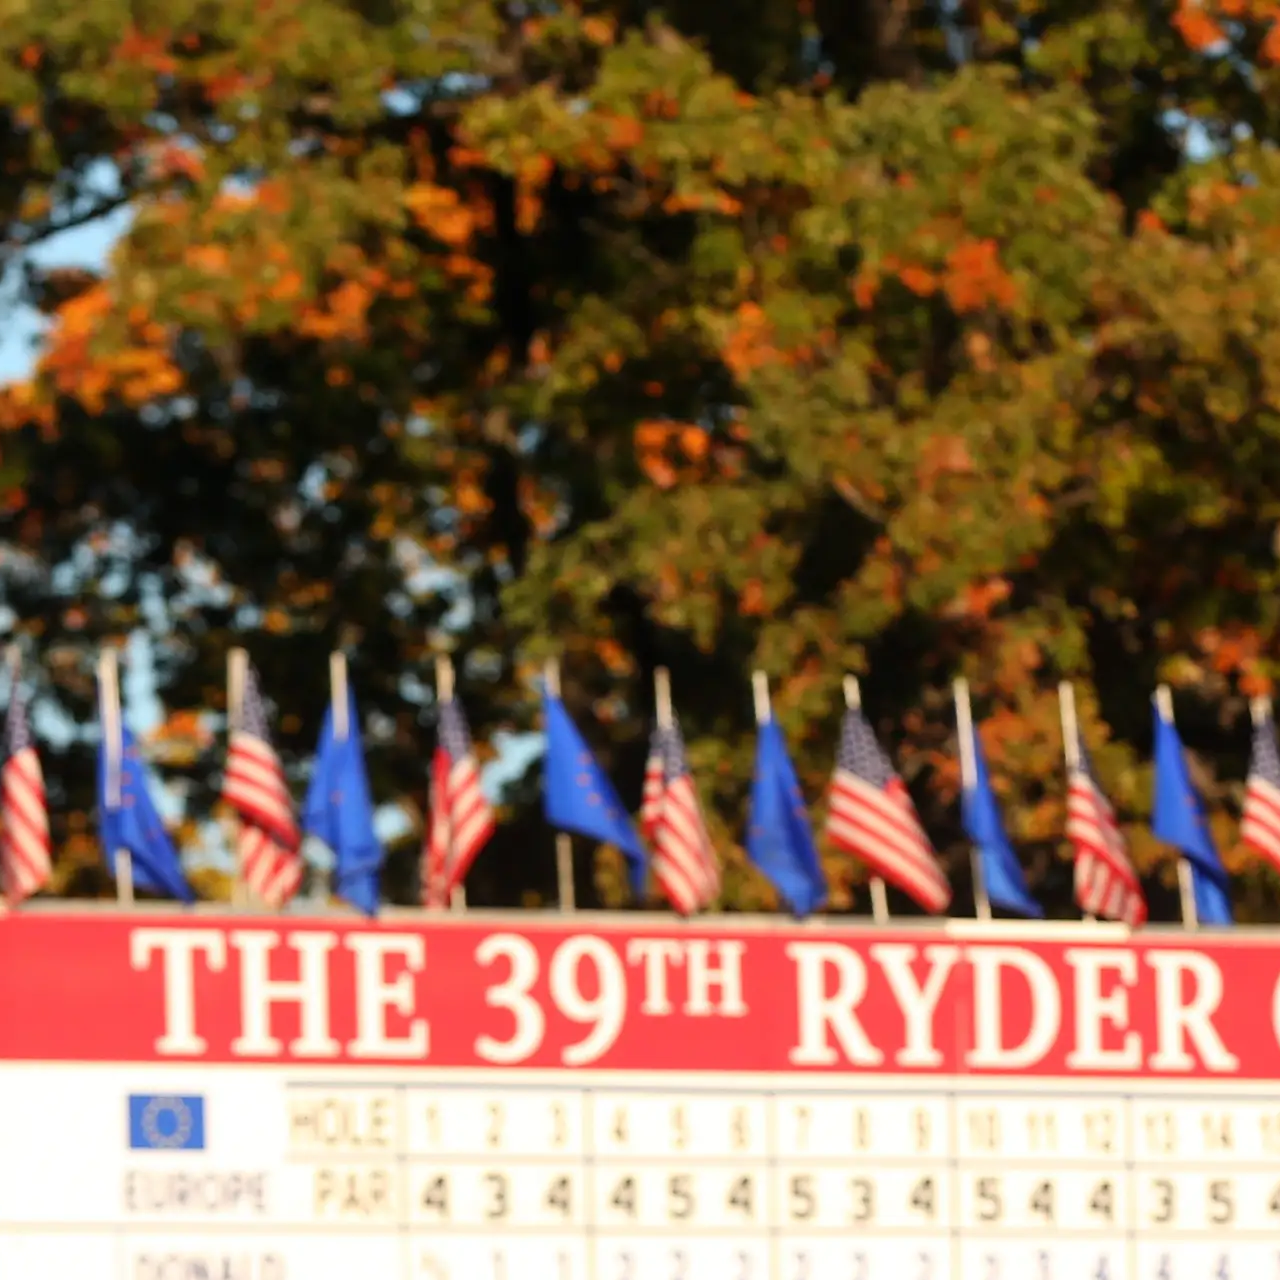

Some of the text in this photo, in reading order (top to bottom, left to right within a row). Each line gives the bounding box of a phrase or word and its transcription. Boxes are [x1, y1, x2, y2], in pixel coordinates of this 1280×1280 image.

[132, 929, 428, 1058] THE
[477, 934, 745, 1064] 39TH
[788, 943, 1237, 1070] RYDER
[290, 1095, 393, 1152] HOLE
[124, 1169, 268, 1217] EUROPE
[312, 1164, 390, 1218] PAR
[419, 1171, 452, 1221] 4
[481, 1169, 513, 1225] 3
[542, 1172, 574, 1219] 4
[606, 1172, 640, 1220] 4
[666, 1171, 697, 1223] 5
[724, 1171, 756, 1221] 4
[787, 1172, 818, 1224] 5
[848, 1174, 878, 1225] 3
[906, 1173, 939, 1222] 4
[972, 1174, 1005, 1228] 5
[1027, 1177, 1057, 1225] 4
[1085, 1176, 1117, 1225] 4
[1148, 1175, 1178, 1228] 3
[1206, 1177, 1237, 1231] 5
